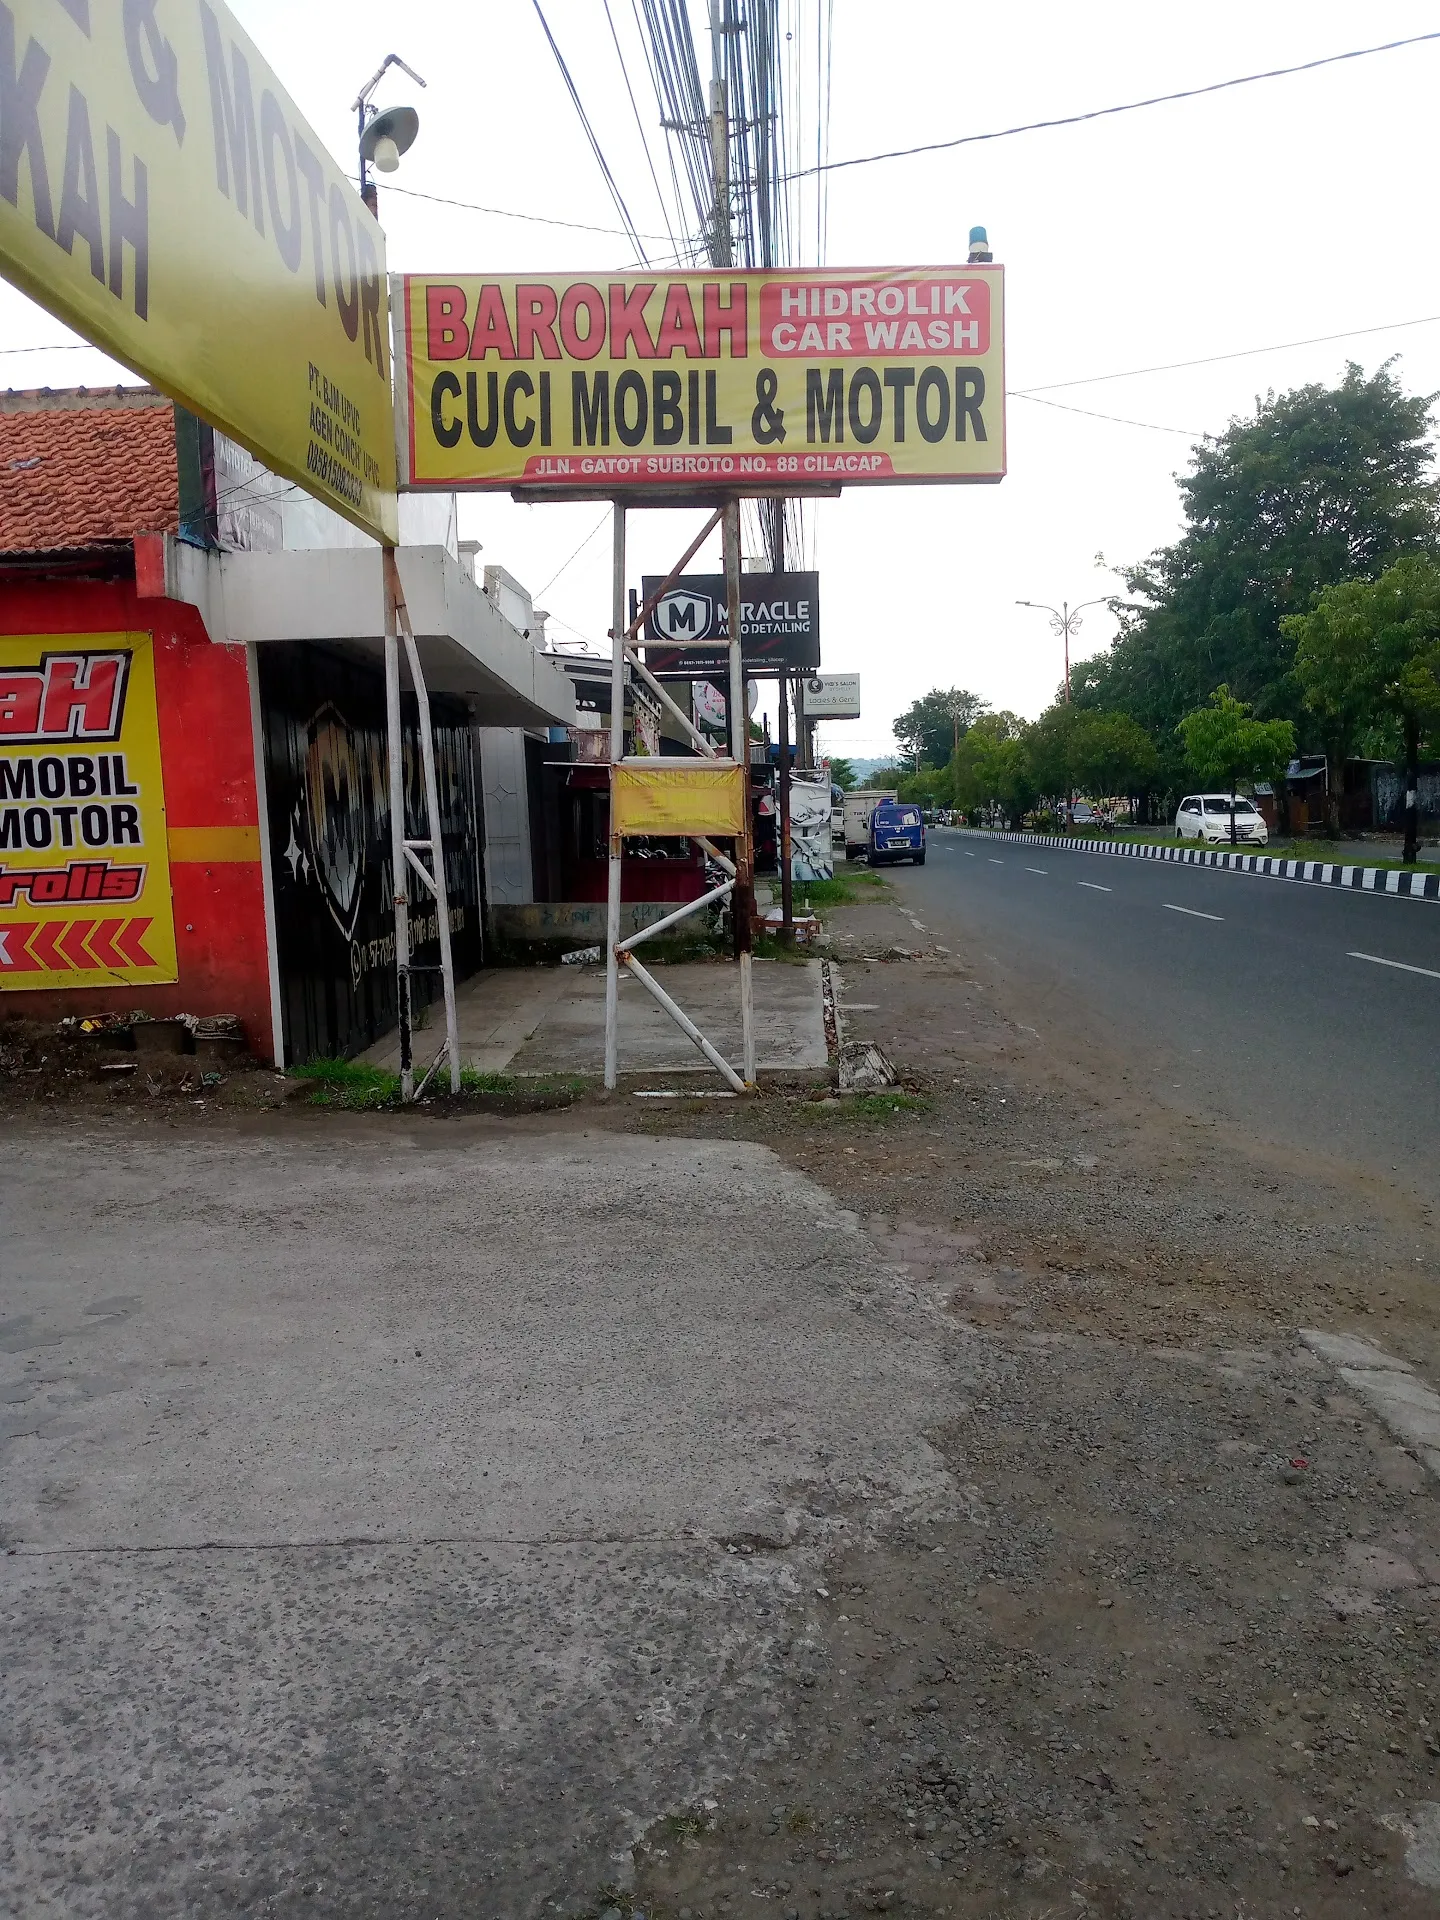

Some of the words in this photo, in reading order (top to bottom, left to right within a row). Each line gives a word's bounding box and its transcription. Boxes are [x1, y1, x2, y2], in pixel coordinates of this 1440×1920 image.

[197, 0, 385, 382] MOTOR
[781, 286, 971, 317] HIDROLIK
[426, 282, 748, 360] BAROKAH
[771, 322, 853, 351] CAR
[863, 321, 979, 350] WASH
[309, 402, 333, 447] AGEN
[431, 370, 552, 448] CUCI
[571, 369, 732, 447] MOBIL
[751, 368, 787, 445] &
[806, 366, 988, 444] MOTOR
[535, 458, 575, 475] JLN.
[581, 457, 640, 474] GATOT
[647, 456, 734, 474] SUBROTO
[740, 456, 771, 473] NO.
[777, 456, 798, 473] 88
[804, 455, 883, 472] CILACAP
[717, 600, 810, 622] MRACLE
[718, 622, 750, 635] AO
[751, 620, 811, 635] DETAILING
[0, 755, 137, 799] MOBIL
